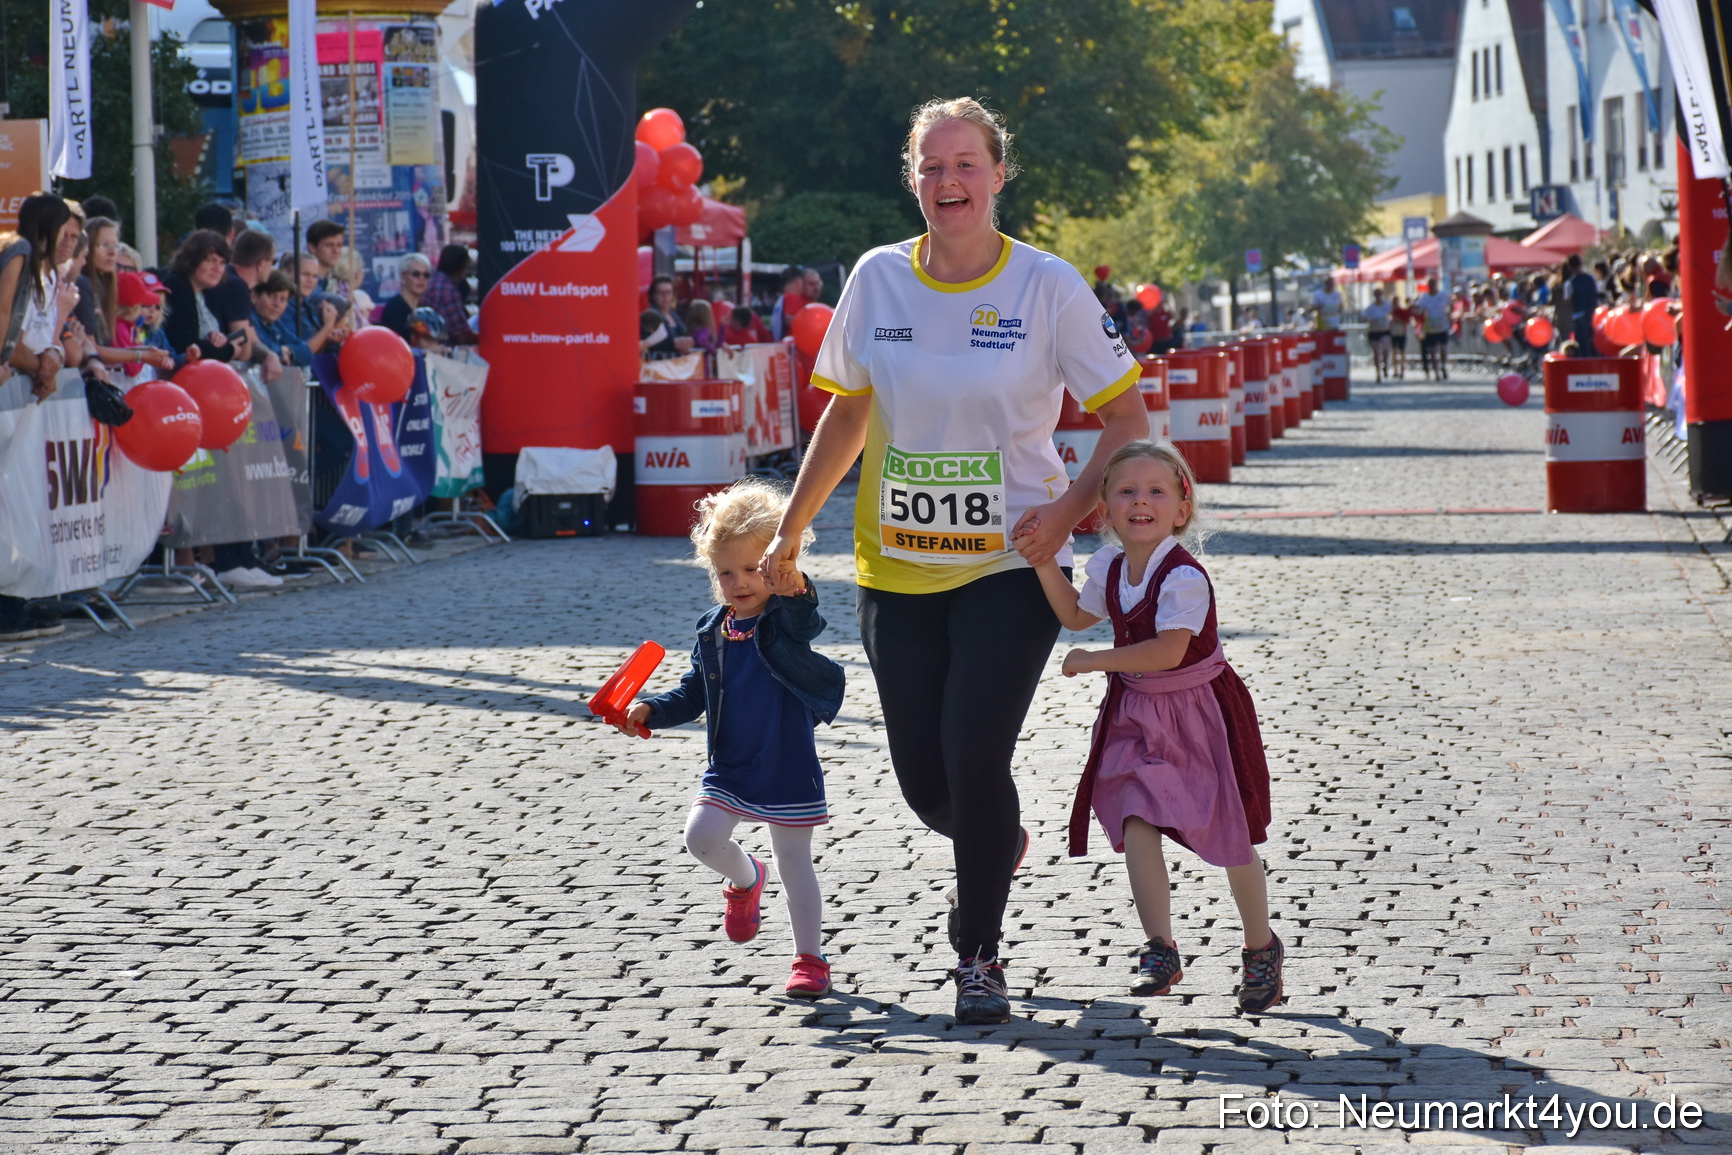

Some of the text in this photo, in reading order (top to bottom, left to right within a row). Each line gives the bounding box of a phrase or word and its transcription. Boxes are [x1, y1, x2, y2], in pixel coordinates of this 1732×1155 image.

[514, 229, 535, 241] THE
[500, 240, 518, 252] 100
[501, 282, 609, 299] BMW Laufsport
[973, 310, 998, 327] 20
[999, 319, 1021, 328] JAHRE
[502, 332, 610, 346] www.bmw-partl.de
[875, 328, 913, 339] BOCK
[971, 328, 1028, 341] Neumarkter
[970, 341, 1016, 352] Stadtlauf
[645, 447, 690, 468] AVIA
[888, 452, 991, 482] BOCK
[891, 488, 990, 526] 5018
[895, 532, 986, 551] STEFANIE
